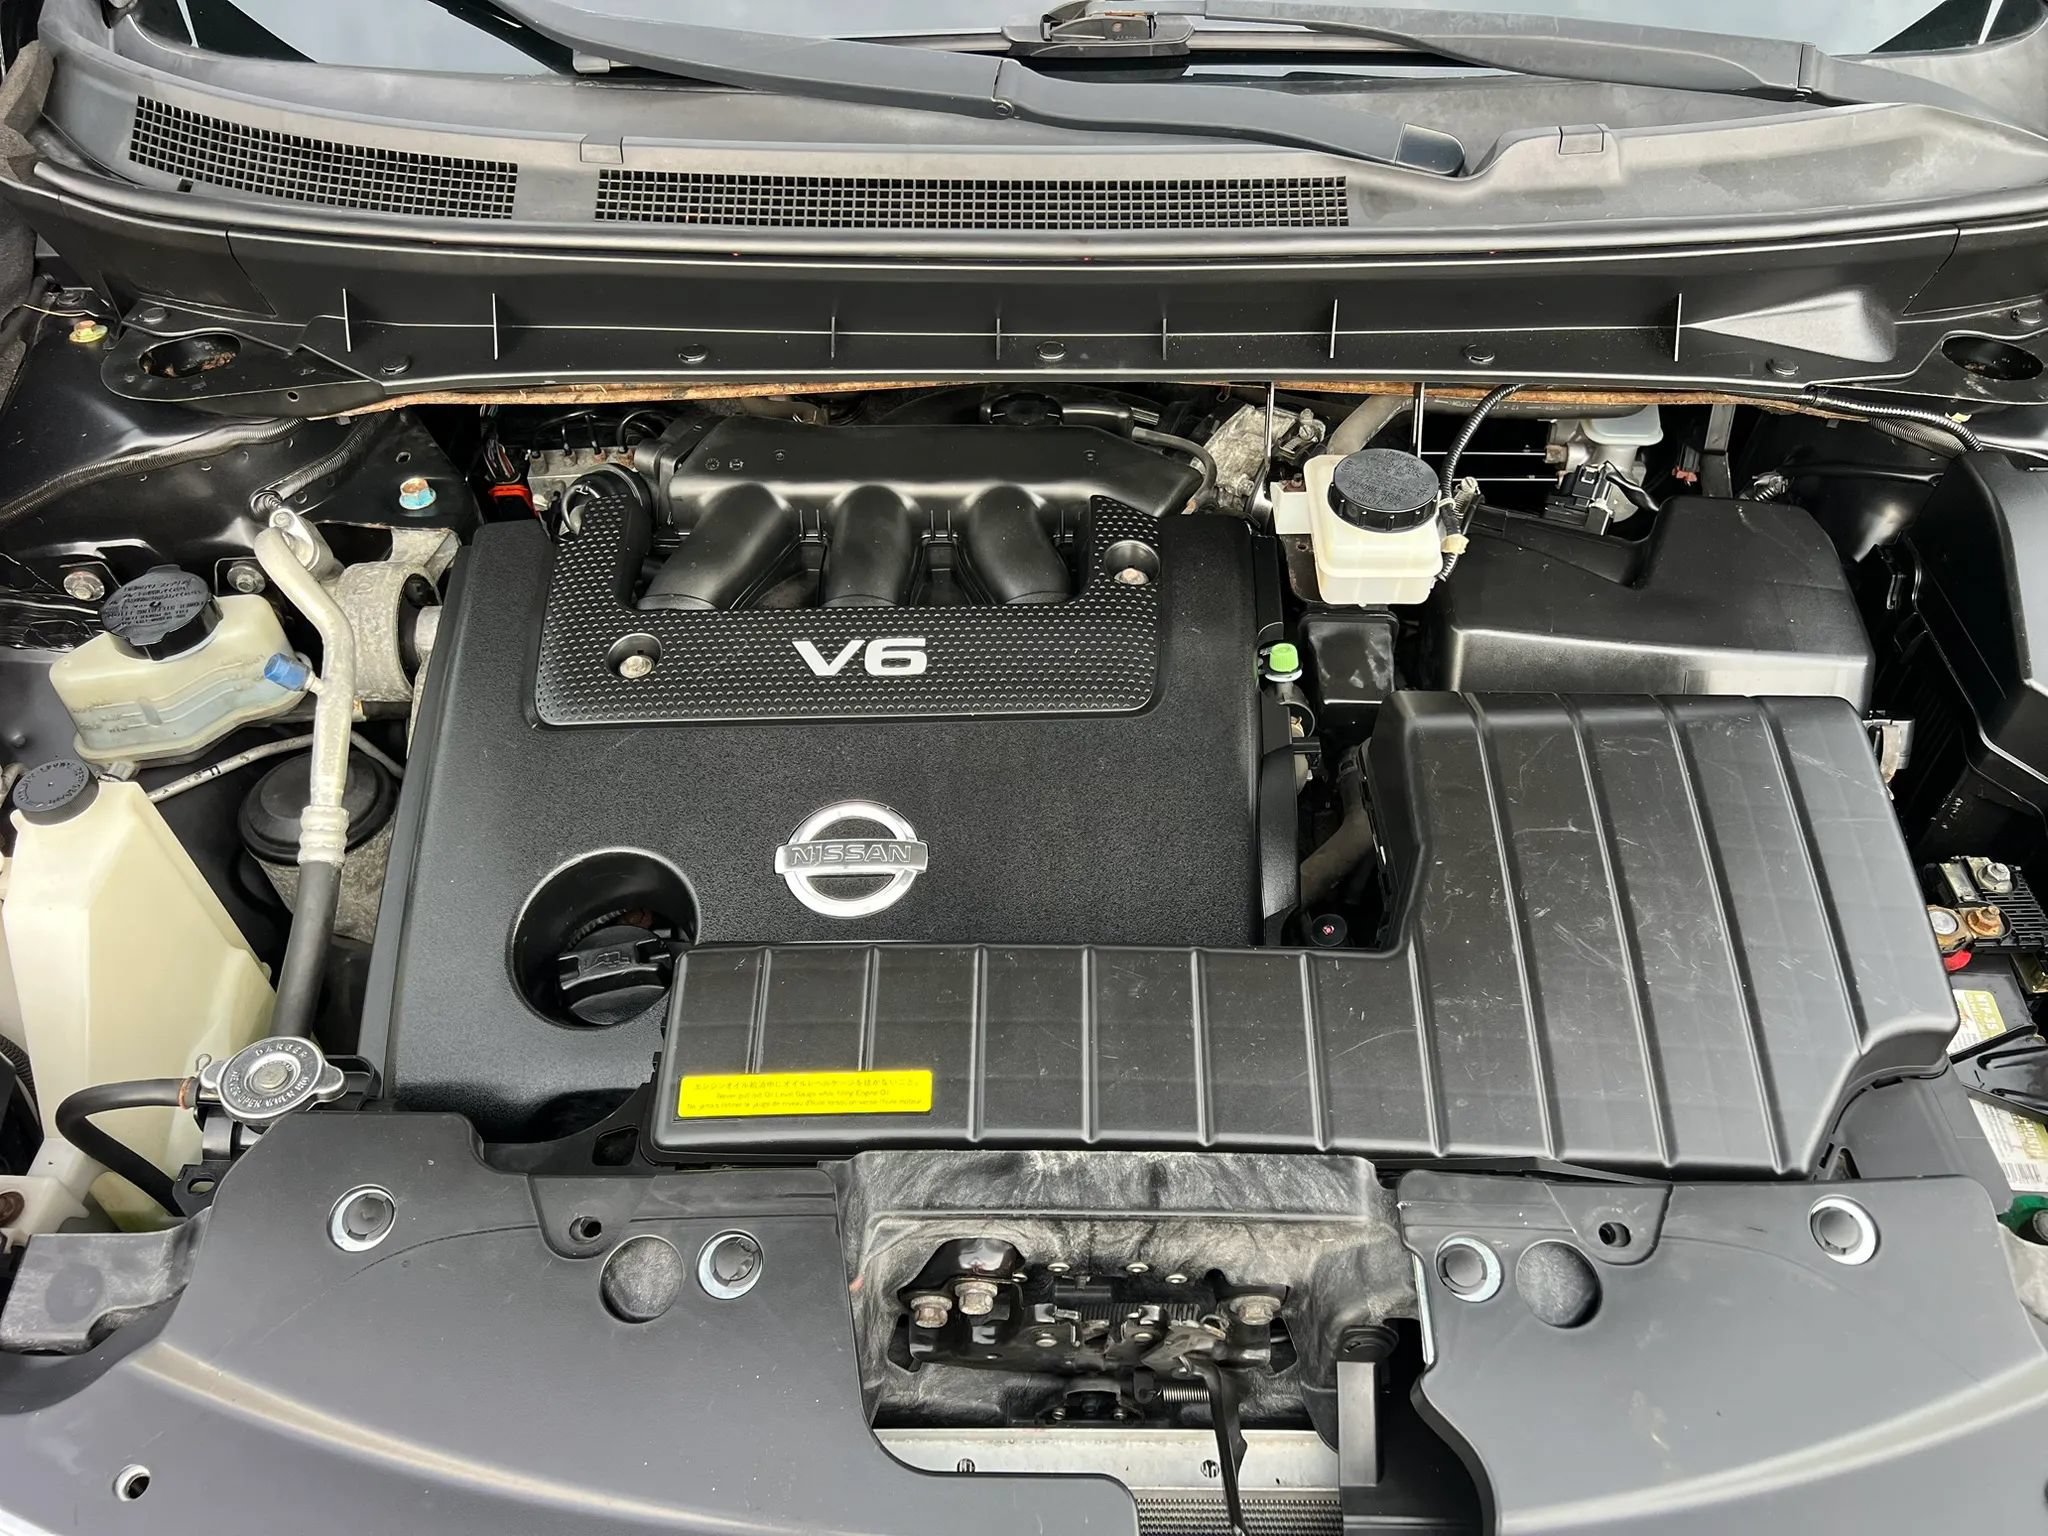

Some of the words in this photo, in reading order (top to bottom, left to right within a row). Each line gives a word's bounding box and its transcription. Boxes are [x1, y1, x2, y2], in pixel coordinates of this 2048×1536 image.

[792, 638, 927, 676] V6
[791, 843, 912, 866] NISSAN
[254, 1043, 309, 1059] DANGER
[238, 1095, 263, 1109] OPEN
